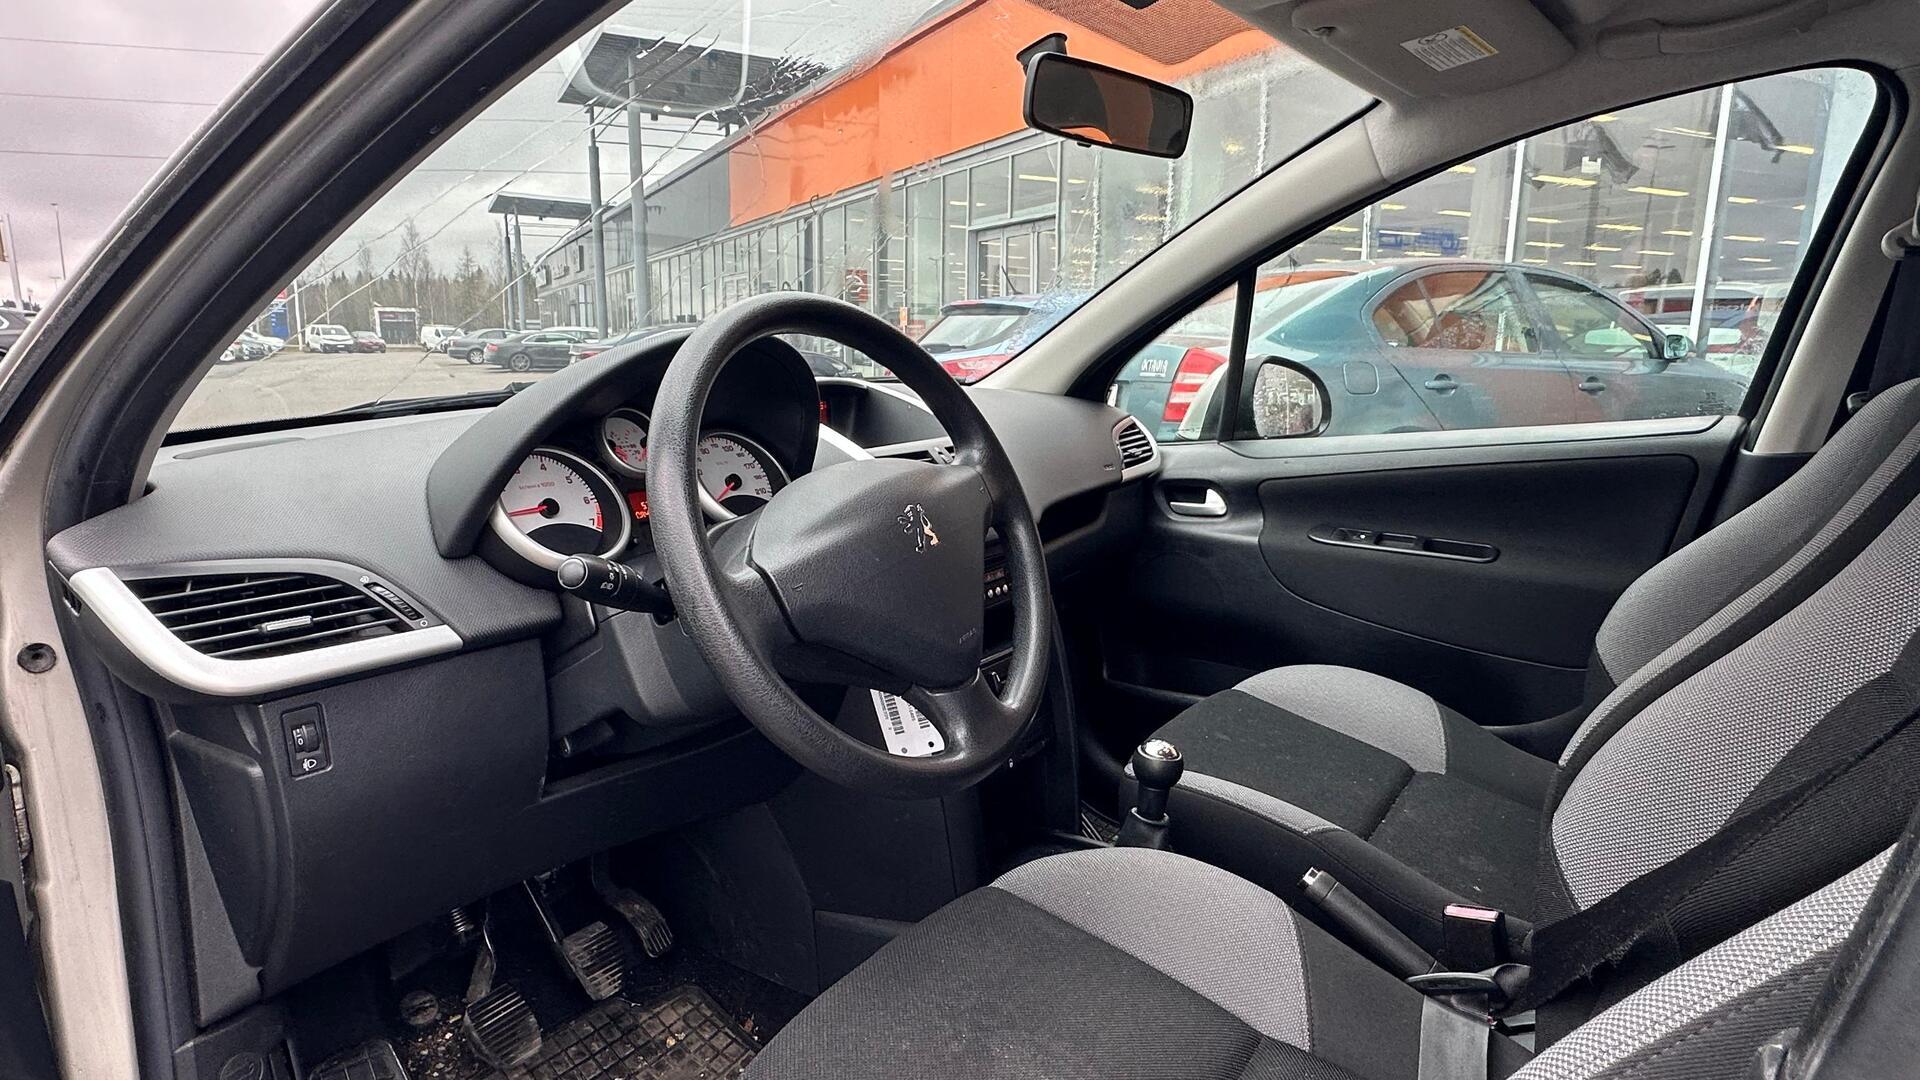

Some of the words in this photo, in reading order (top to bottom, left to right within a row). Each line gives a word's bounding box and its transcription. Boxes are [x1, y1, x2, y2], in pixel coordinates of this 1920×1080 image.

[540, 463, 547, 471] 4
[565, 475, 573, 484] 5
[755, 487, 767, 495] 210
[583, 496, 590, 505] 6
[589, 518, 595, 526] 7
